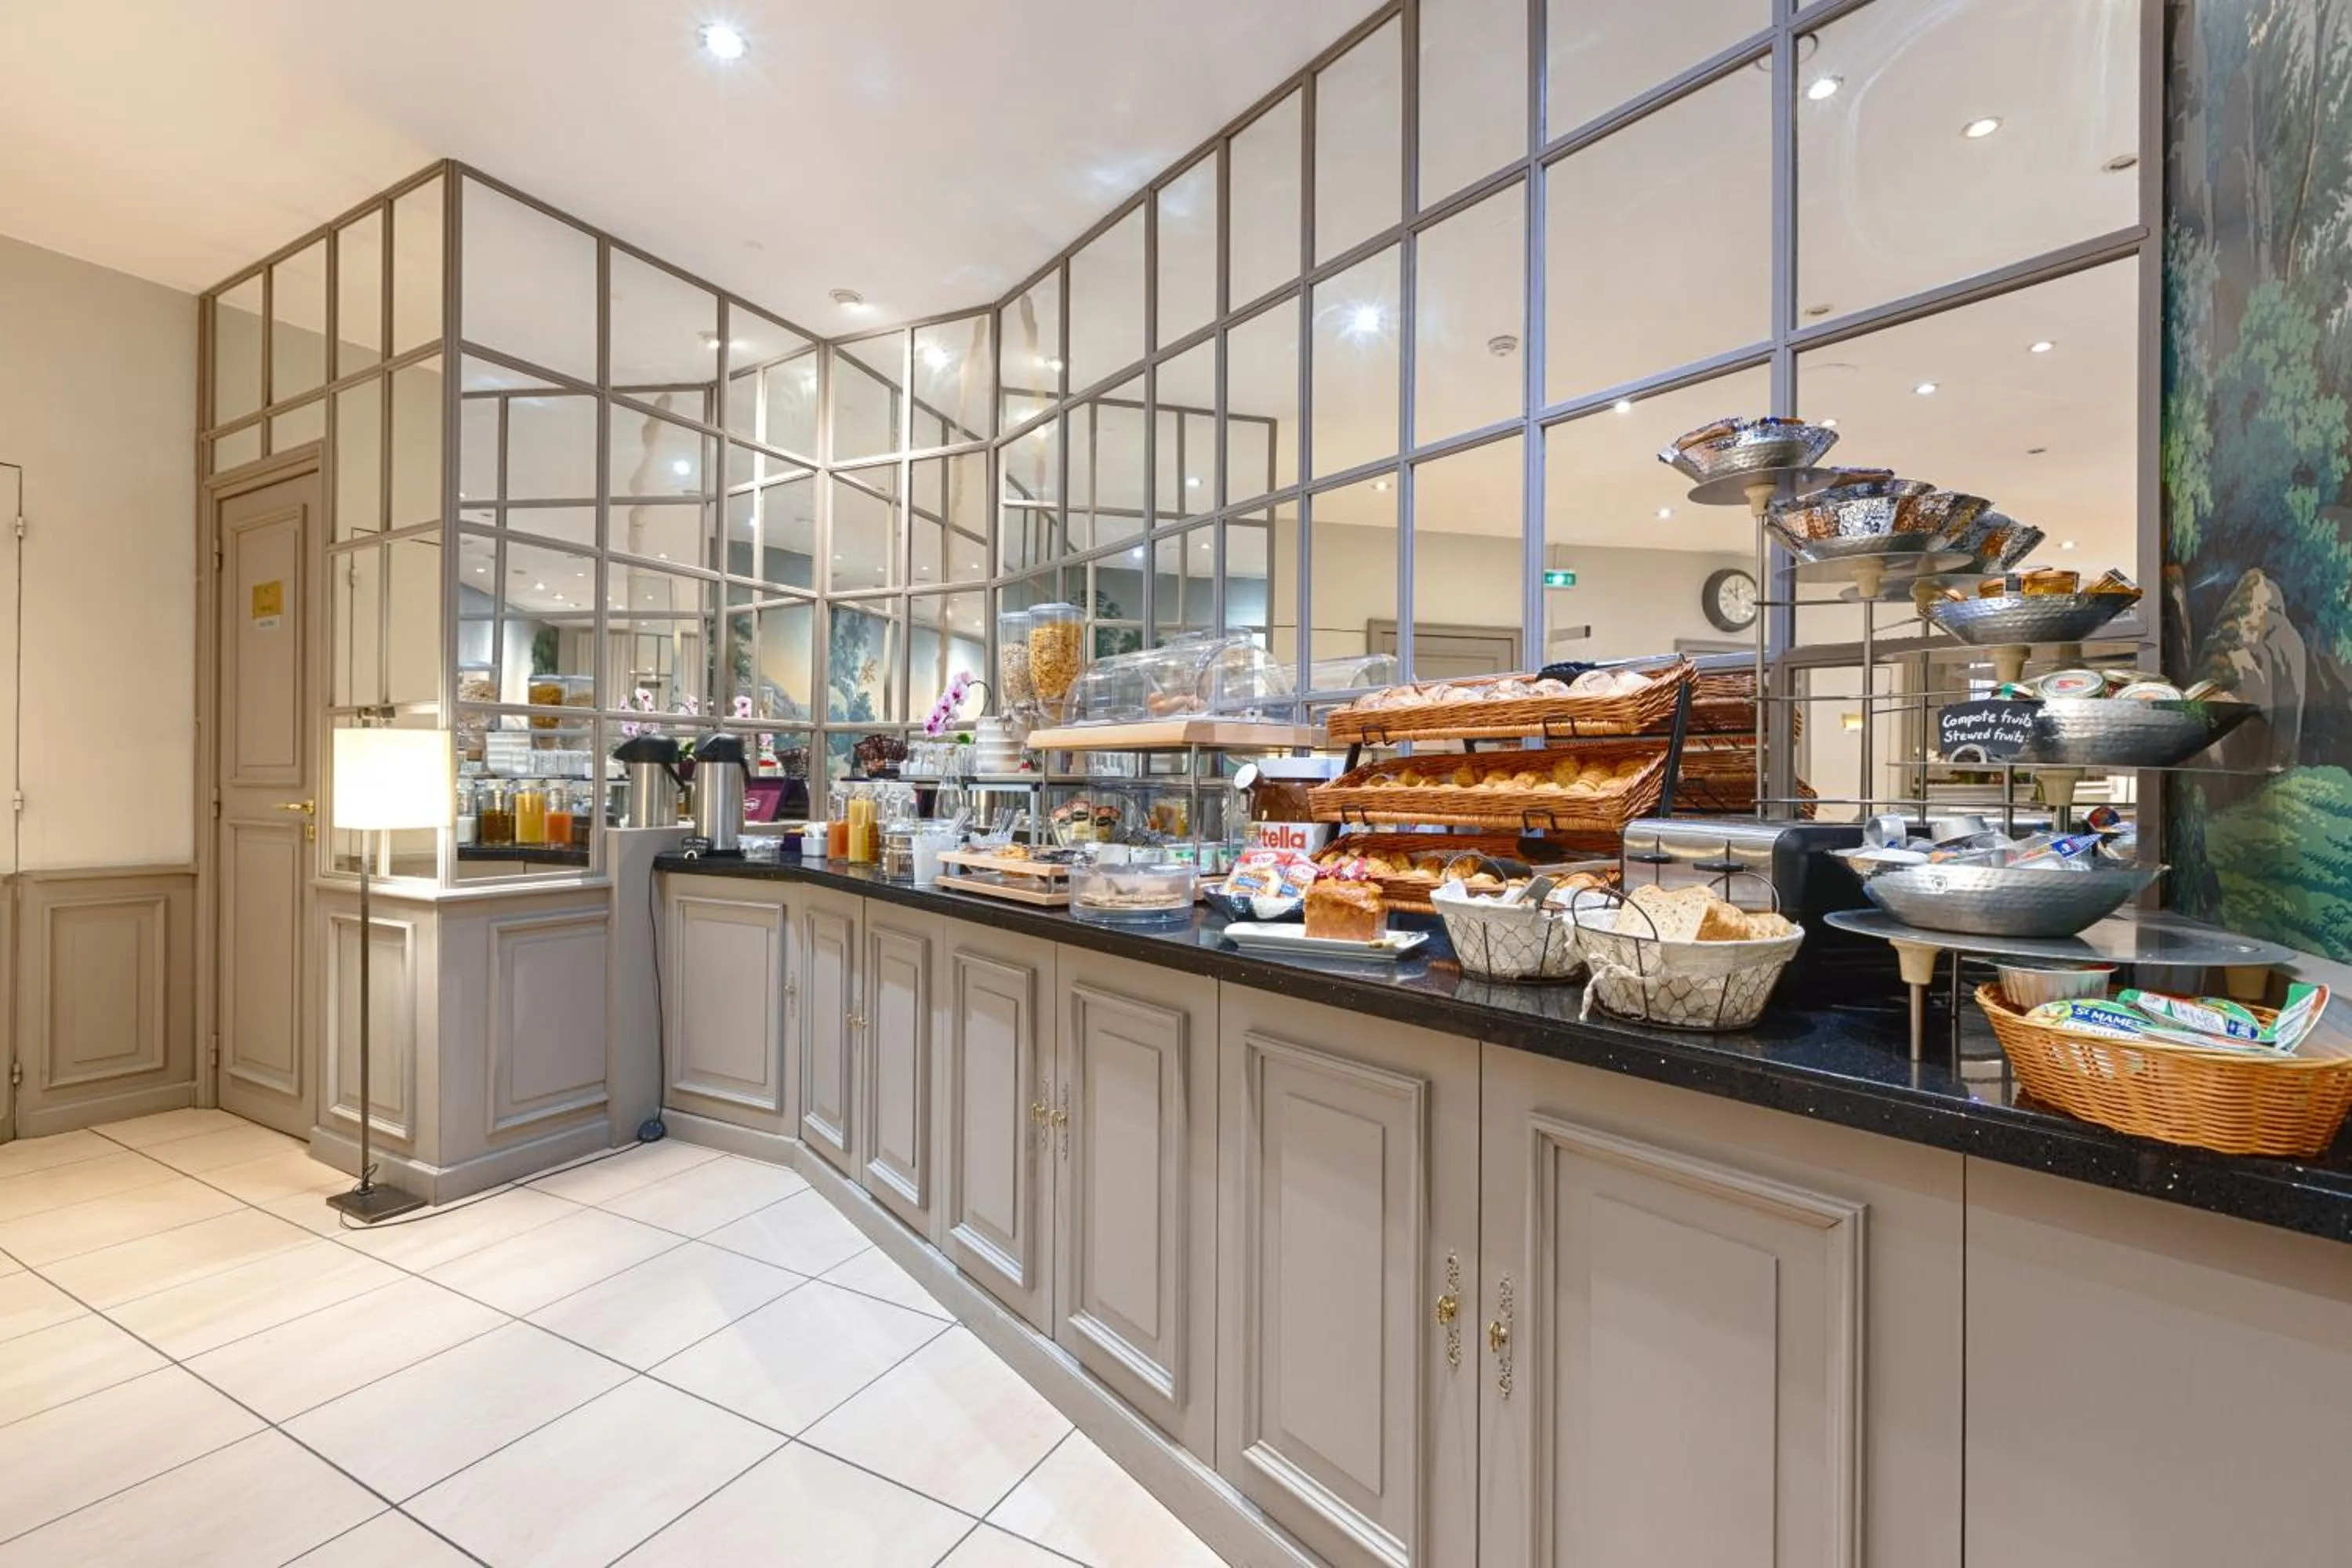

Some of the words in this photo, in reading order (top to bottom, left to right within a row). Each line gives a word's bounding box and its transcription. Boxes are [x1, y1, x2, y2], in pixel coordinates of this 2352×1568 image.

[1942, 709, 1997, 728] Compote
[1944, 728, 1991, 742] Stewed
[1994, 728, 2024, 743] fruits
[1258, 826, 1306, 849] tella
